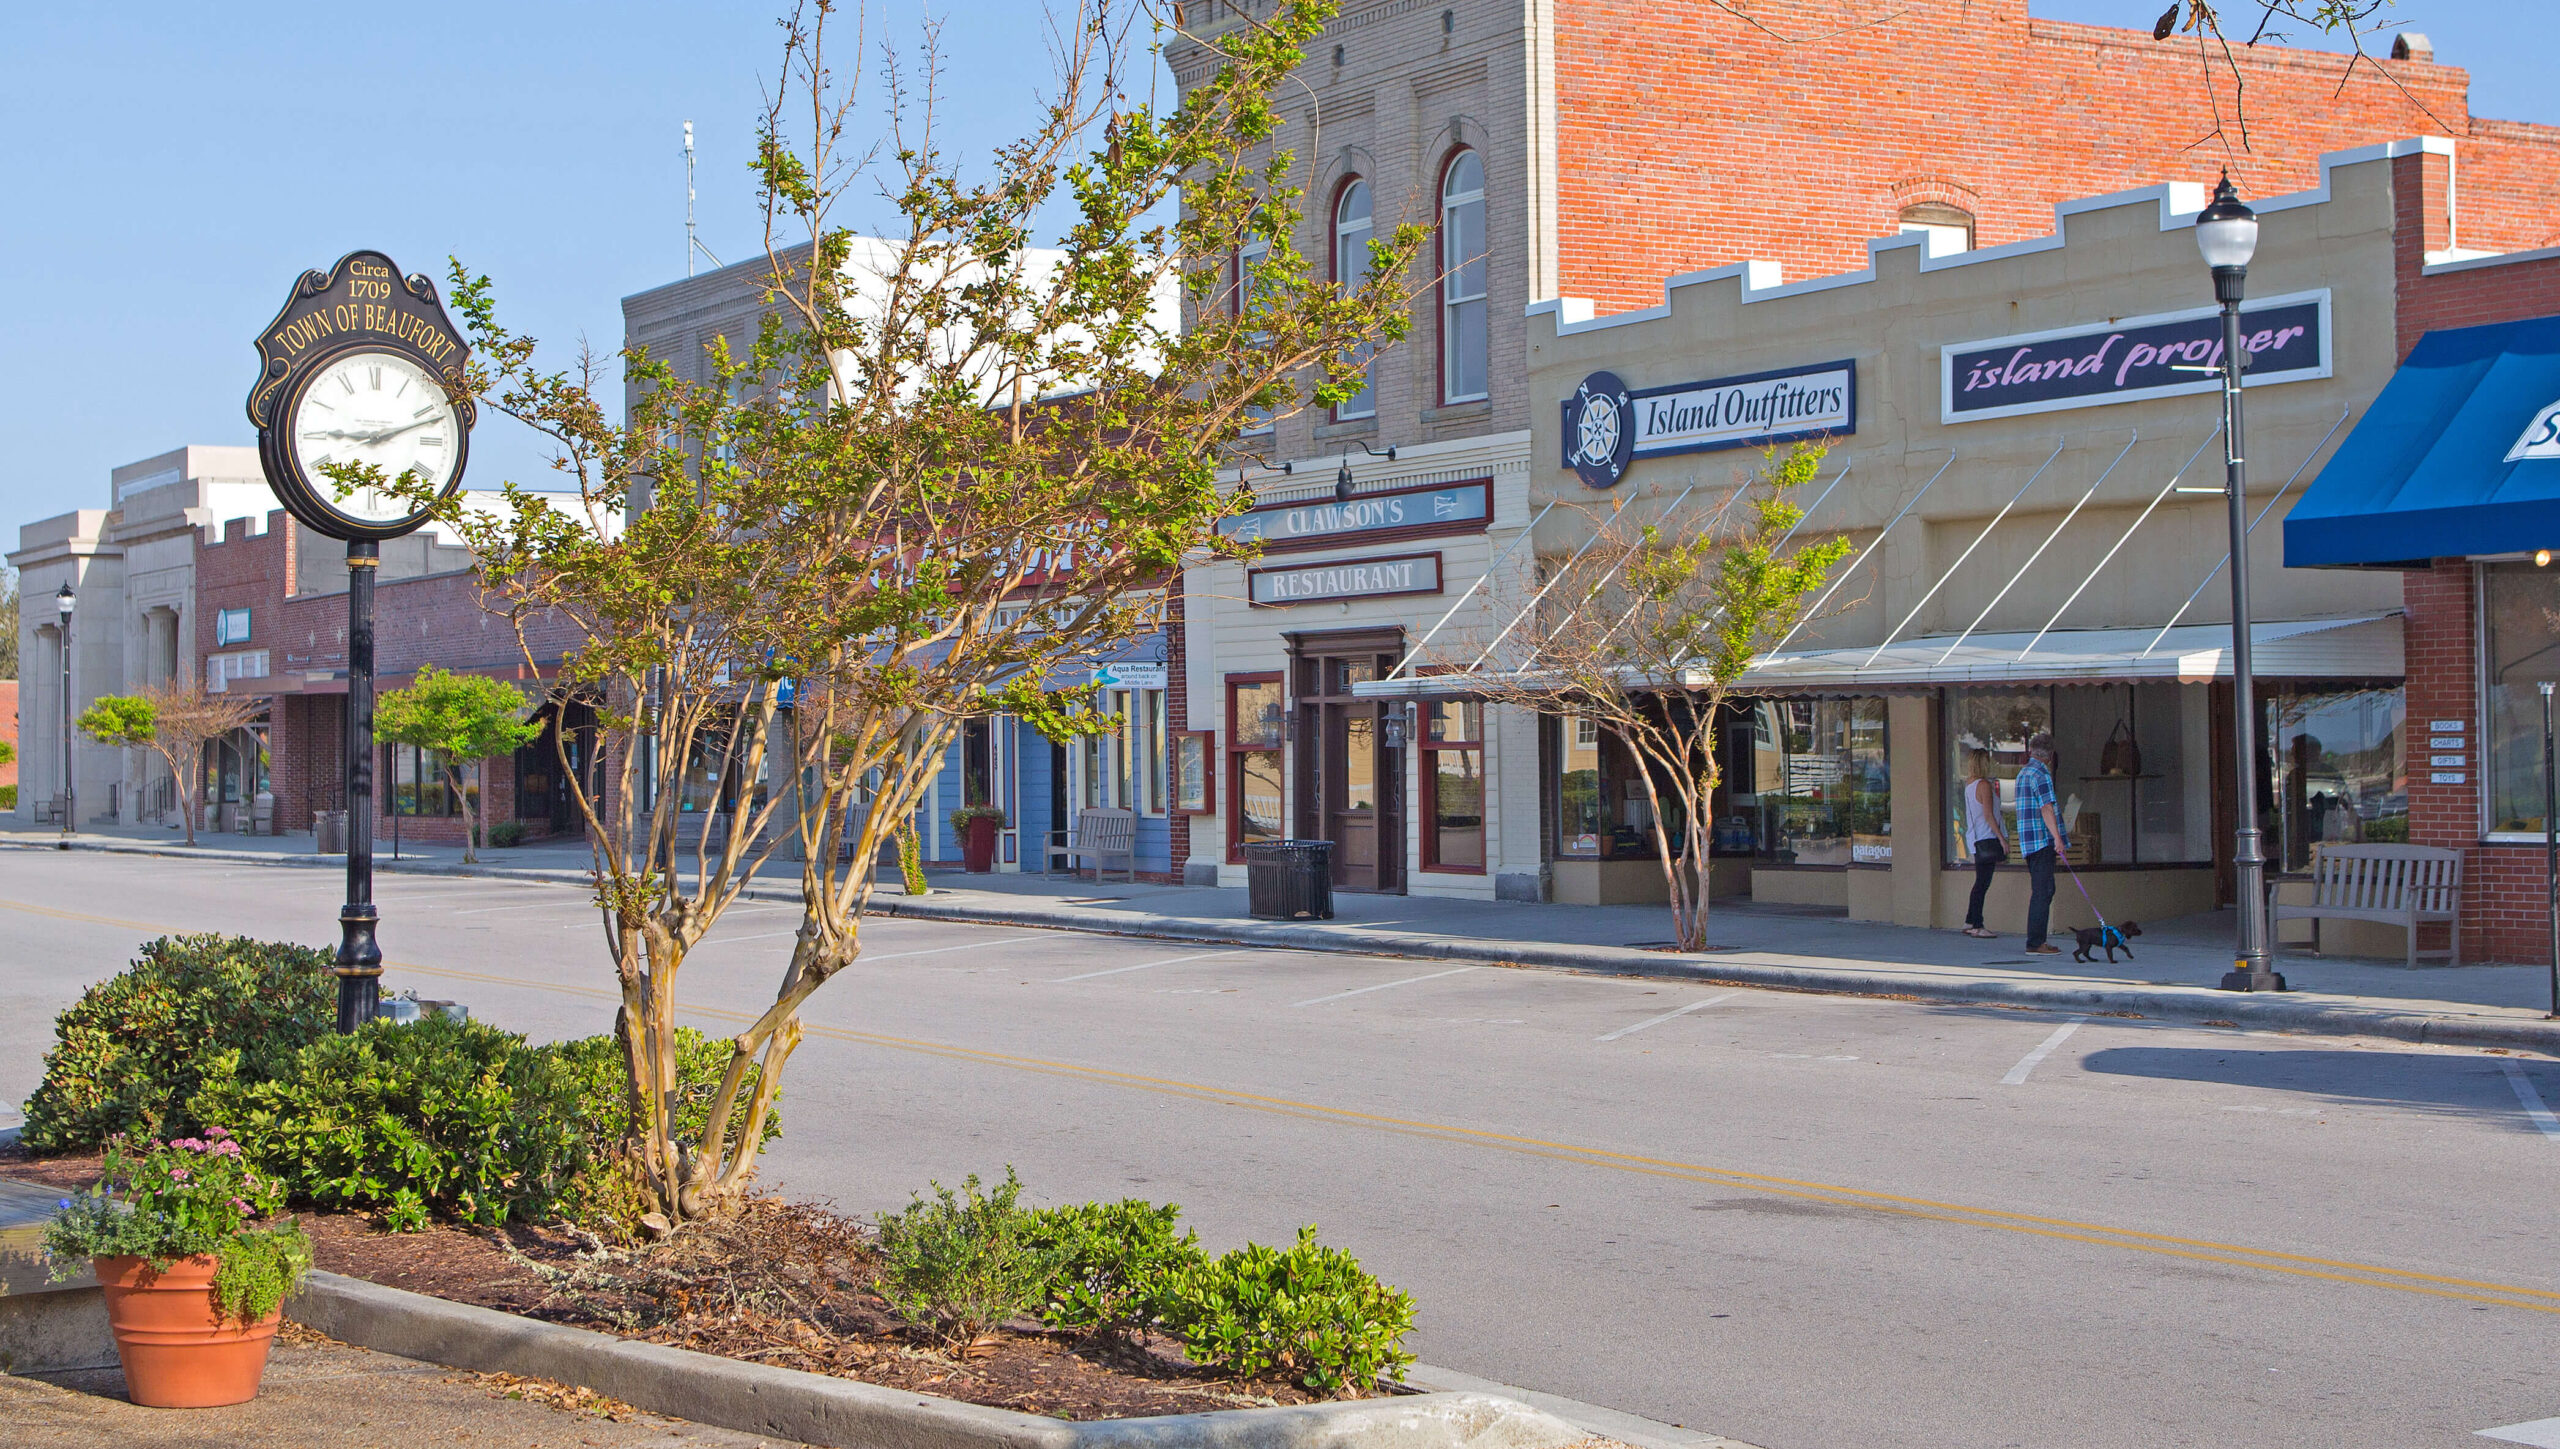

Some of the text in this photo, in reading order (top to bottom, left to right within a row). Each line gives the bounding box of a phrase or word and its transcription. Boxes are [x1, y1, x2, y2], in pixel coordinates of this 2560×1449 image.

[350, 260, 389, 278] Circa
[348, 280, 391, 300] 1709
[275, 303, 457, 364] TOWN OF BEAUFORT
[1964, 334, 2124, 392] island
[1579, 382, 1589, 399] N
[1617, 391, 1628, 407] E
[1646, 382, 1842, 436] Island Outfitters
[2526, 411, 2560, 447] S
[1571, 450, 1581, 467] W
[1610, 463, 1620, 478] S
[1287, 499, 1403, 535] CLAWSON'S
[1273, 563, 1413, 598] RESTAURANT
[1112, 665, 1166, 673] Aqua Restaurant
[2432, 739, 2460, 747] CHARTS
[2438, 774, 2456, 782] TOYS
